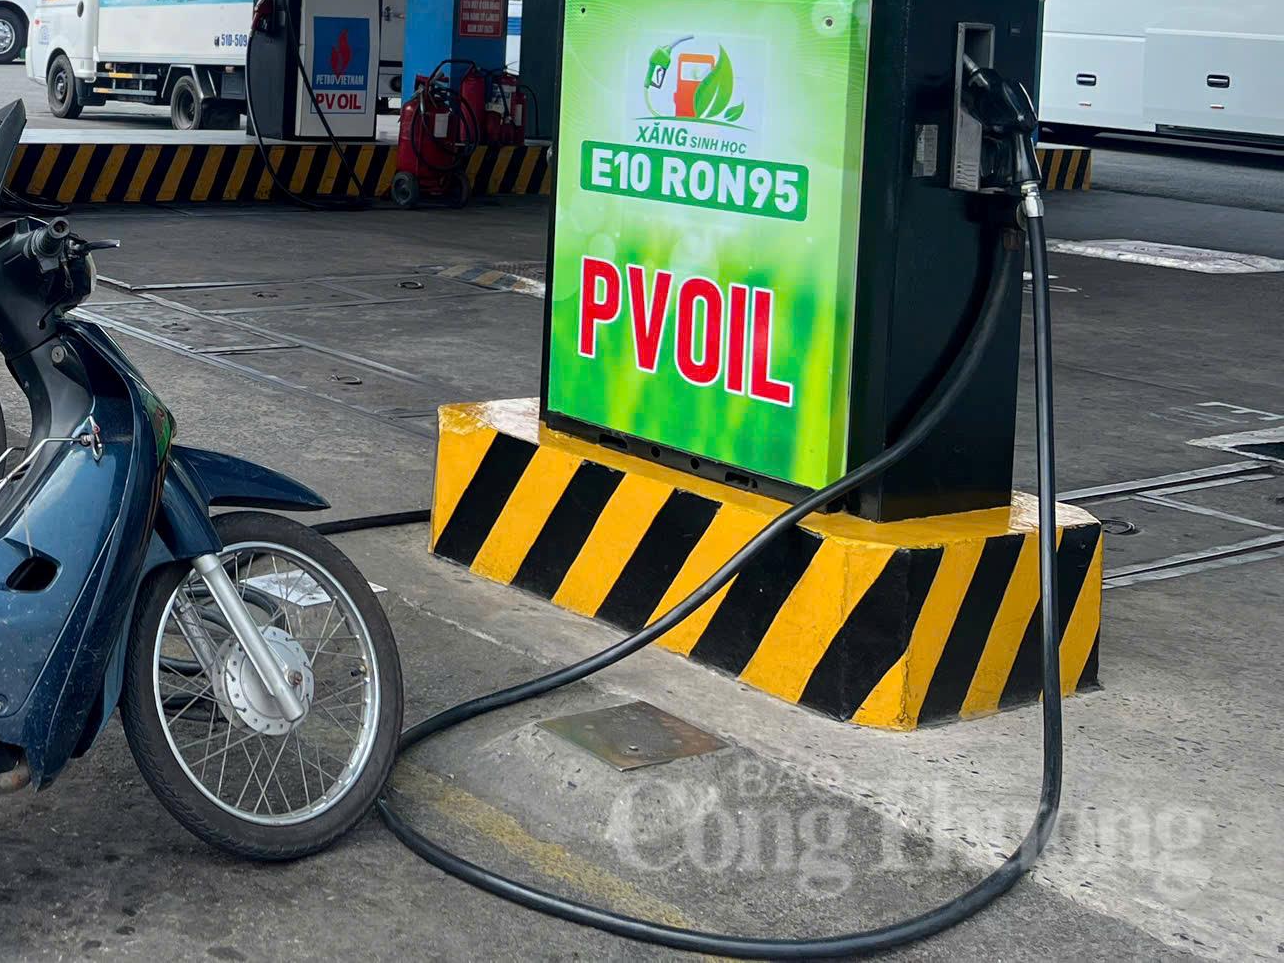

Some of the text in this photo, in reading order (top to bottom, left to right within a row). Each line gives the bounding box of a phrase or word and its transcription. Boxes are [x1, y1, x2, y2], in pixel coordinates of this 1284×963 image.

[315, 74, 365, 86] PETROVIETNAM
[635, 121, 748, 156] XĂNG SINH HỌC
[590, 147, 800, 214] E10 RON95
[577, 255, 794, 408] PVOIL
